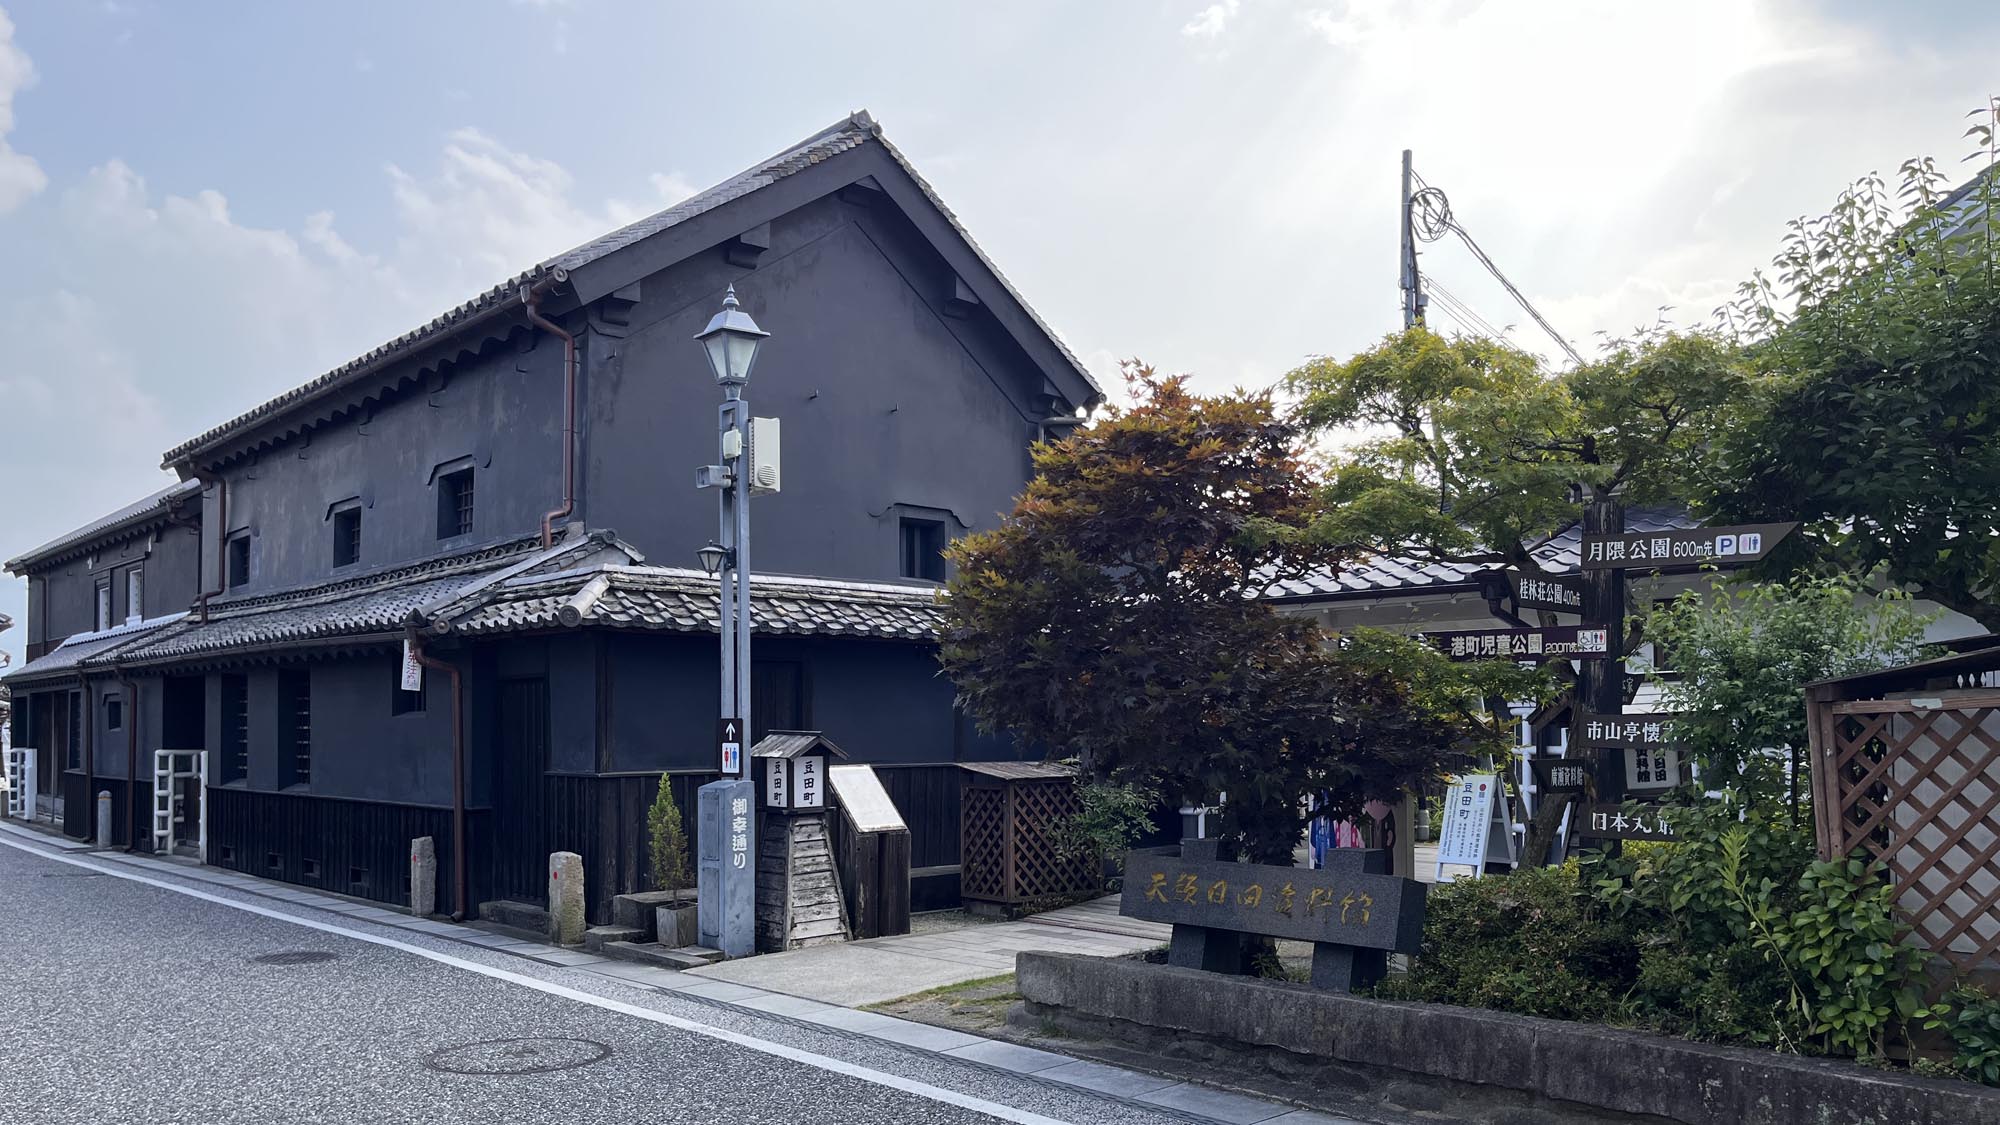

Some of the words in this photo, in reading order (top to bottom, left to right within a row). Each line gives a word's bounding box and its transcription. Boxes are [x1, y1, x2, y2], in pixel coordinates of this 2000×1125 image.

[1588, 537, 1671, 561] 月隈公園
[1519, 578, 1562, 604] 桂林荘公園
[1451, 633, 1542, 656] 港町児童公園
[773, 761, 783, 805] 豆田町
[803, 761, 815, 805] 豆田町
[1460, 783, 1472, 819] 豆田町
[732, 798, 747, 869] 御幸通り
